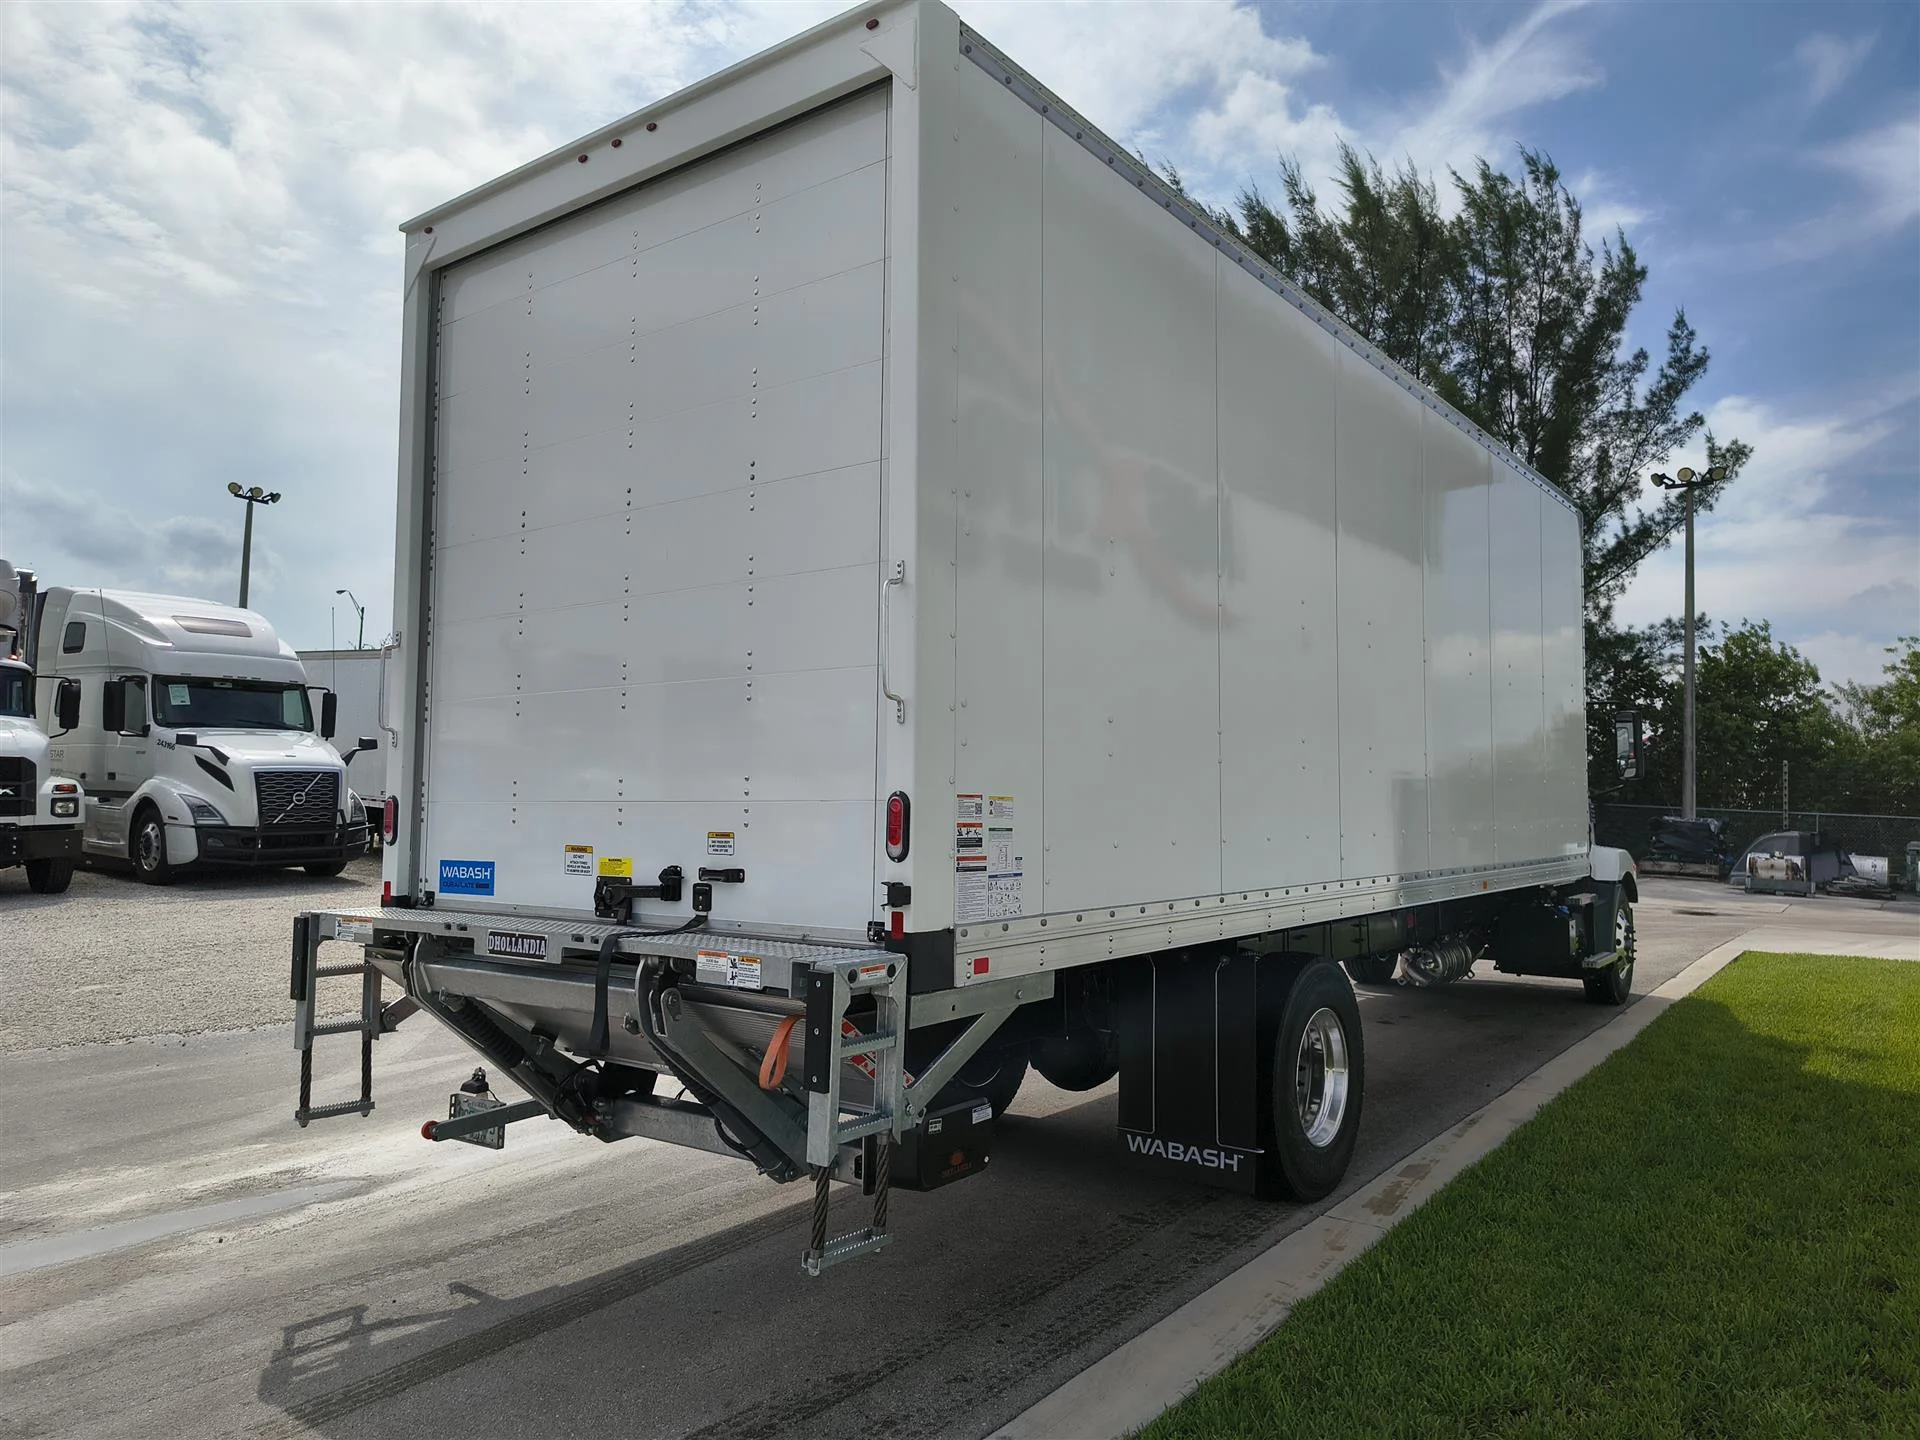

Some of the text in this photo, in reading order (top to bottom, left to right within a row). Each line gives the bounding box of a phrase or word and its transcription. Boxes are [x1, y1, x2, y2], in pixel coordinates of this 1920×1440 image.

[442, 866, 491, 879] WABASH
[489, 936, 546, 955] DHOLLANDIA
[1127, 1134, 1238, 1172] WABASH
